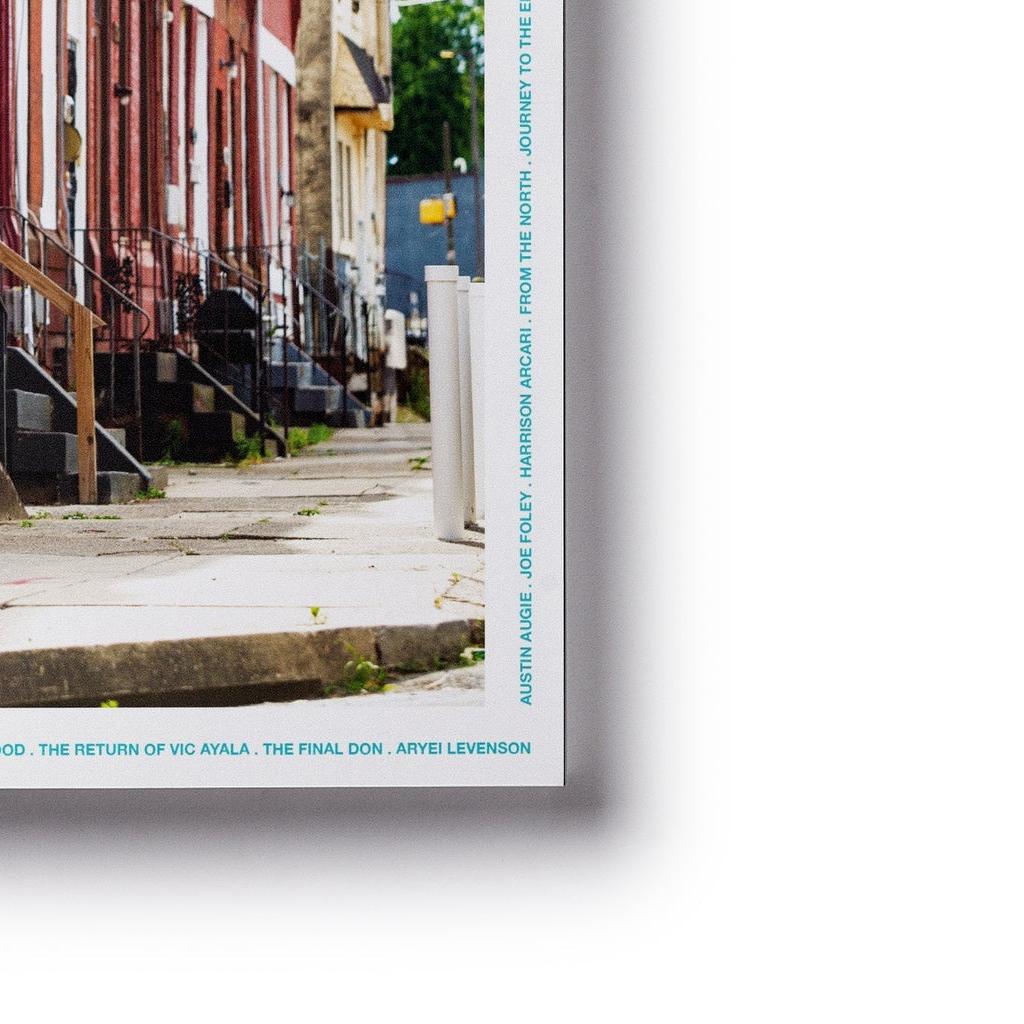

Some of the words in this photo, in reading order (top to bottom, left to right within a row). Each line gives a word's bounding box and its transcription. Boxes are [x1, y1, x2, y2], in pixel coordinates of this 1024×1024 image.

[518, 18, 533, 48] THE
[518, 52, 533, 74] TO
[518, 80, 533, 156] JOURNEY
[518, 170, 533, 227] NORTH
[518, 232, 533, 261] THE
[518, 266, 533, 316] FROM
[519, 328, 533, 389] ARCARI
[519, 393, 533, 479] HARRISON
[519, 492, 533, 544] FOLEY
[519, 548, 533, 579] JOE
[519, 592, 533, 642] AUGIE
[519, 646, 533, 705] AUSTIN
[39, 742, 69, 756] THE
[73, 742, 141, 756] RETURN
[144, 742, 165, 756] OF
[170, 742, 195, 756] VIC
[200, 742, 250, 756] AYALA
[263, 741, 293, 756] THE
[297, 741, 343, 756] FINAL
[348, 741, 384, 756] DON
[396, 741, 442, 756] ARYEI
[446, 740, 532, 756] LEVENSON
